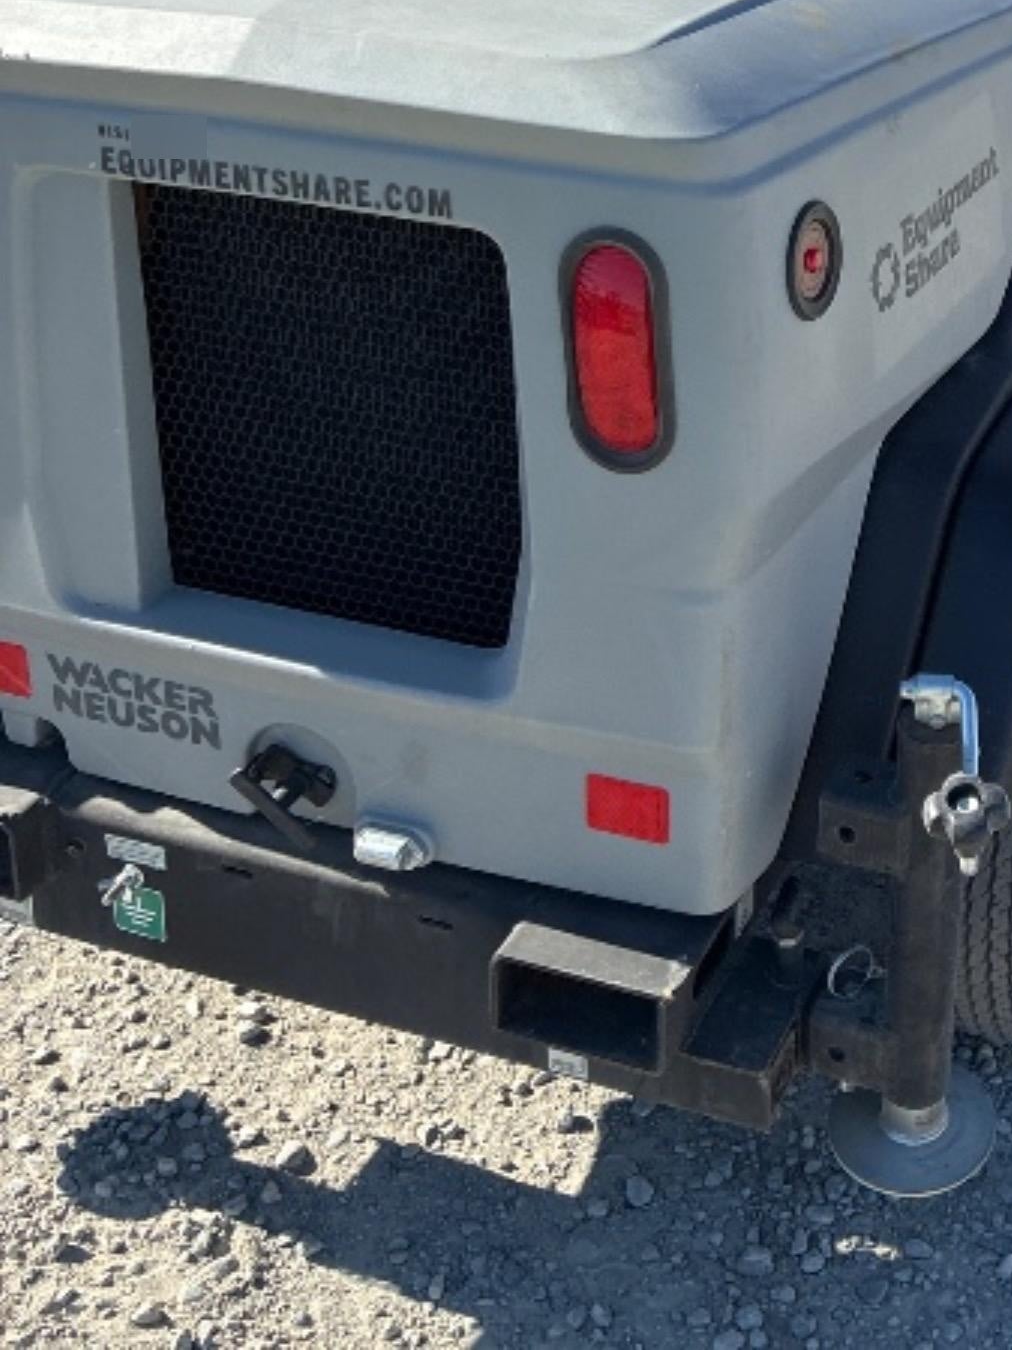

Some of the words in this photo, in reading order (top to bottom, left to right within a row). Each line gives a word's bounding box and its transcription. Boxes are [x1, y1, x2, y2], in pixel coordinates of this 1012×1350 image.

[101, 146, 454, 219] EQUIPMENTSHARE.COM
[900, 146, 999, 256] Equipment
[905, 227, 961, 298] Share
[46, 653, 219, 719] WACKER
[52, 683, 223, 751] NEUSON
